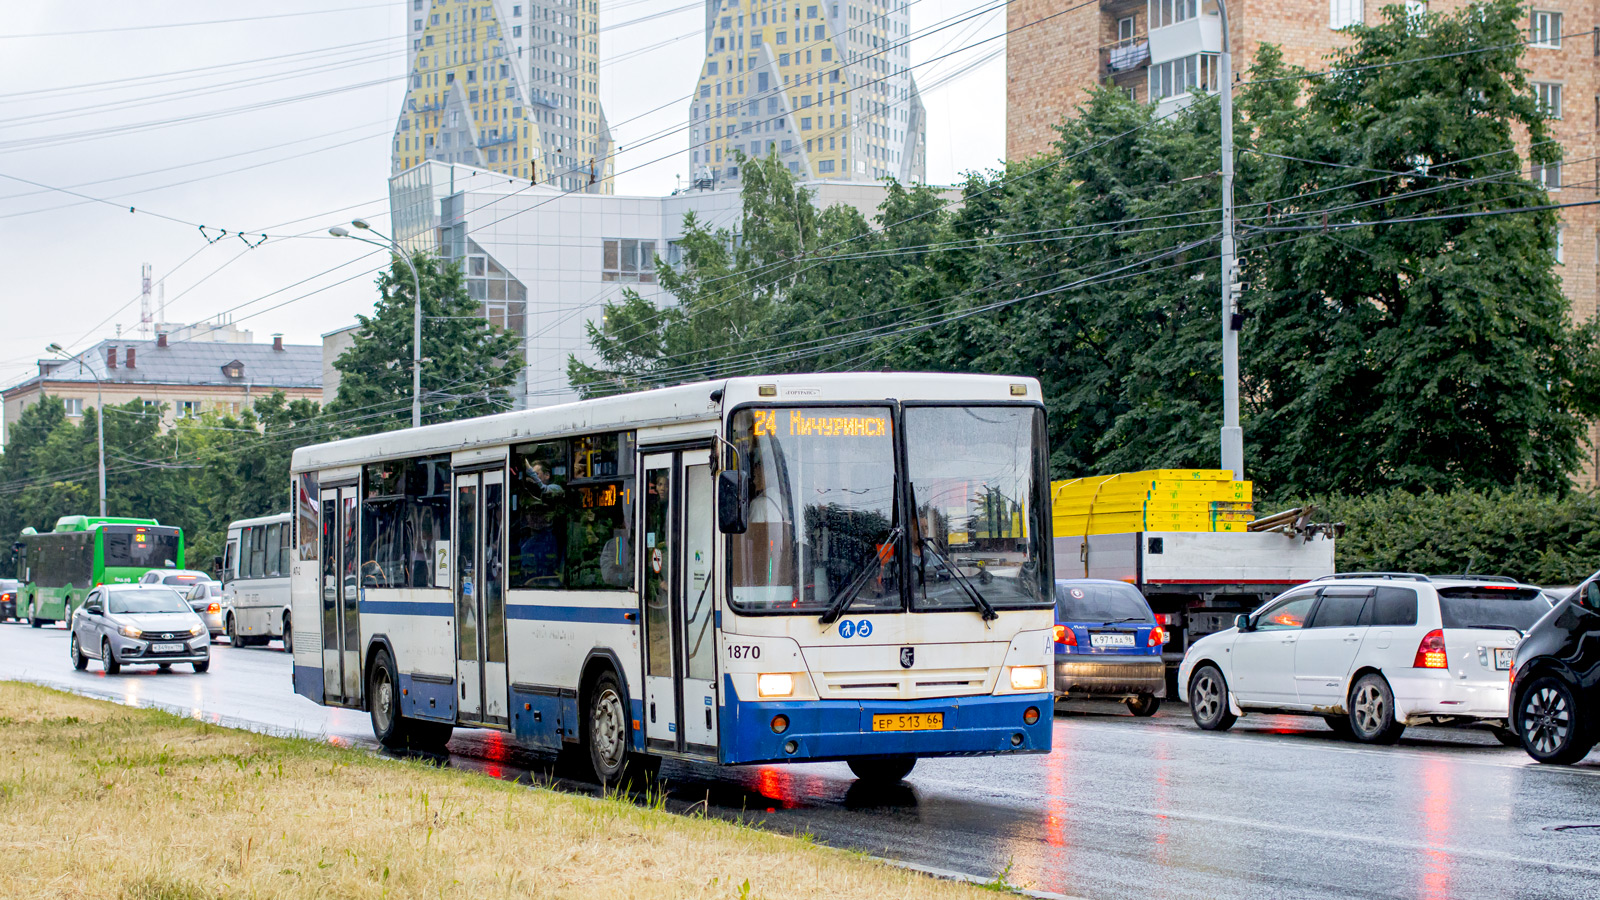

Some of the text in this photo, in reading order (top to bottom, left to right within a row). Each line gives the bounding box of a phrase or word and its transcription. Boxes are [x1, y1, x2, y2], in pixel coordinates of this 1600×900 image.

[753, 410, 886, 436] 24 Мичуринск
[135, 534, 146, 542] 24
[728, 645, 761, 660] 1870
[899, 716, 920, 729] 513
[926, 715, 939, 725] 66
